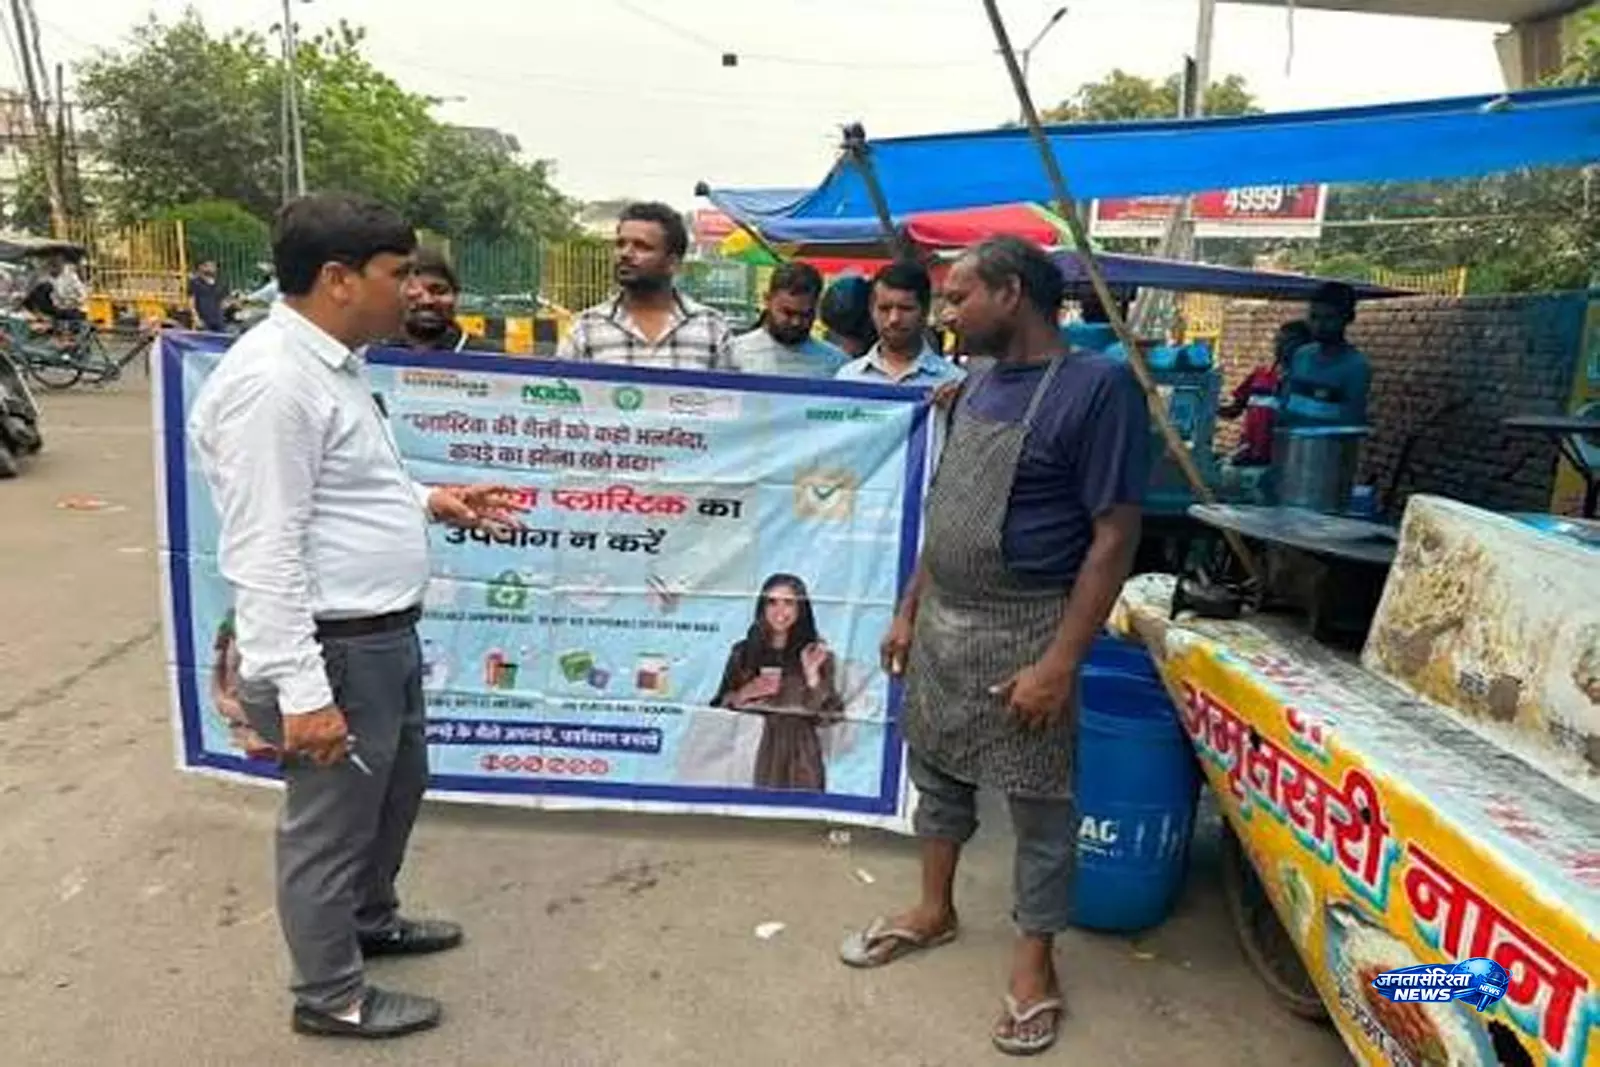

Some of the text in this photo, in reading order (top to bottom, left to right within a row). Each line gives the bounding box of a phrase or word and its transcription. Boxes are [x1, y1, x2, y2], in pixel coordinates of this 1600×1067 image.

[1223, 186, 1282, 212] 4999
[552, 485, 688, 515] प्लास्टिक
[697, 498, 743, 518] का
[570, 531, 597, 550] न
[607, 528, 667, 554] करें
[1404, 843, 1590, 1053] नान
